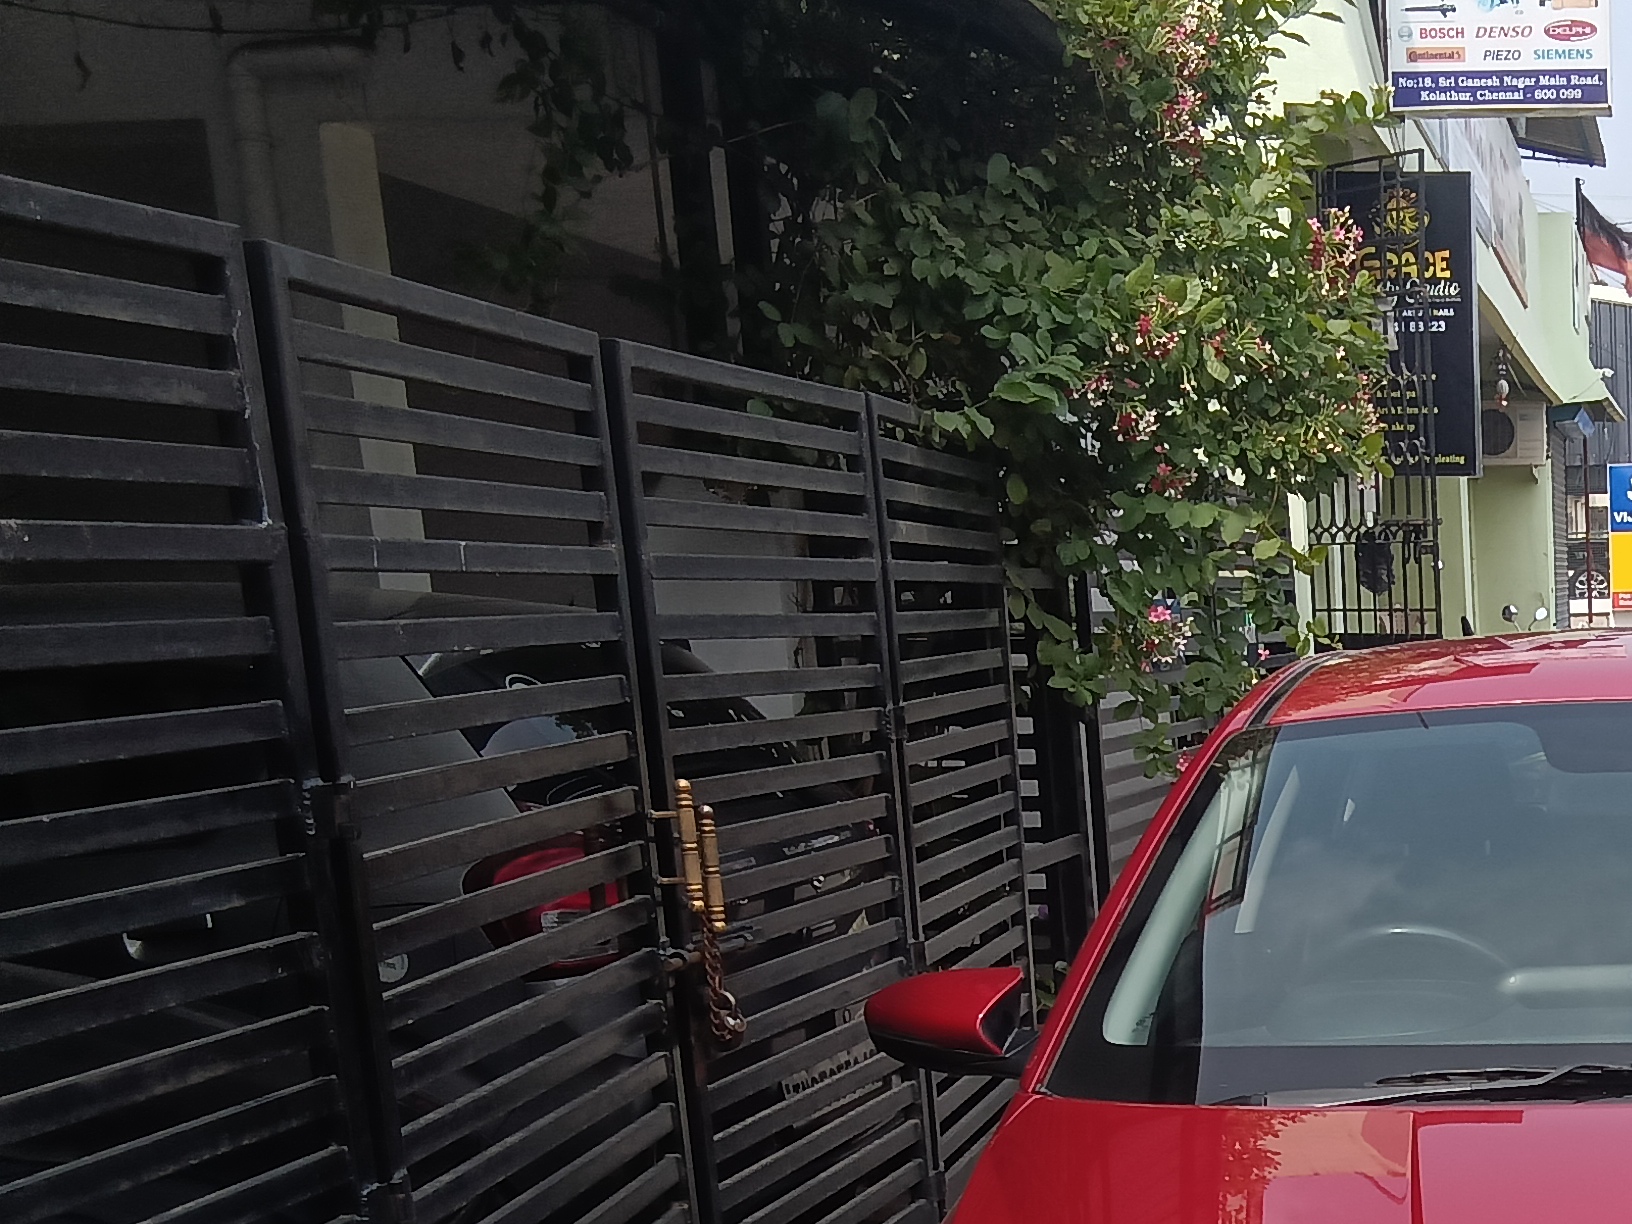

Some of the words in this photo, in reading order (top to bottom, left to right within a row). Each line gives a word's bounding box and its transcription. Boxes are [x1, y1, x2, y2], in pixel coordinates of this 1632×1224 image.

[1419, 27, 1465, 40] BOSCH
[1475, 25, 1533, 39] DENSO
[1408, 49, 1455, 62] Continental
[1483, 49, 1522, 61] PIEZO
[1533, 48, 1593, 60] SIEMENS
[1438, 77, 1455, 88] Sri
[1458, 76, 1500, 88] Ganesh
[1503, 76, 1536, 89] Nagar
[1538, 75, 1568, 87] Main
[1570, 74, 1604, 86] Road,
[1420, 89, 1474, 102] Kolathur,
[1476, 88, 1524, 100] Chennai
[1534, 89, 1558, 100] 600
[1559, 88, 1582, 99] 099
